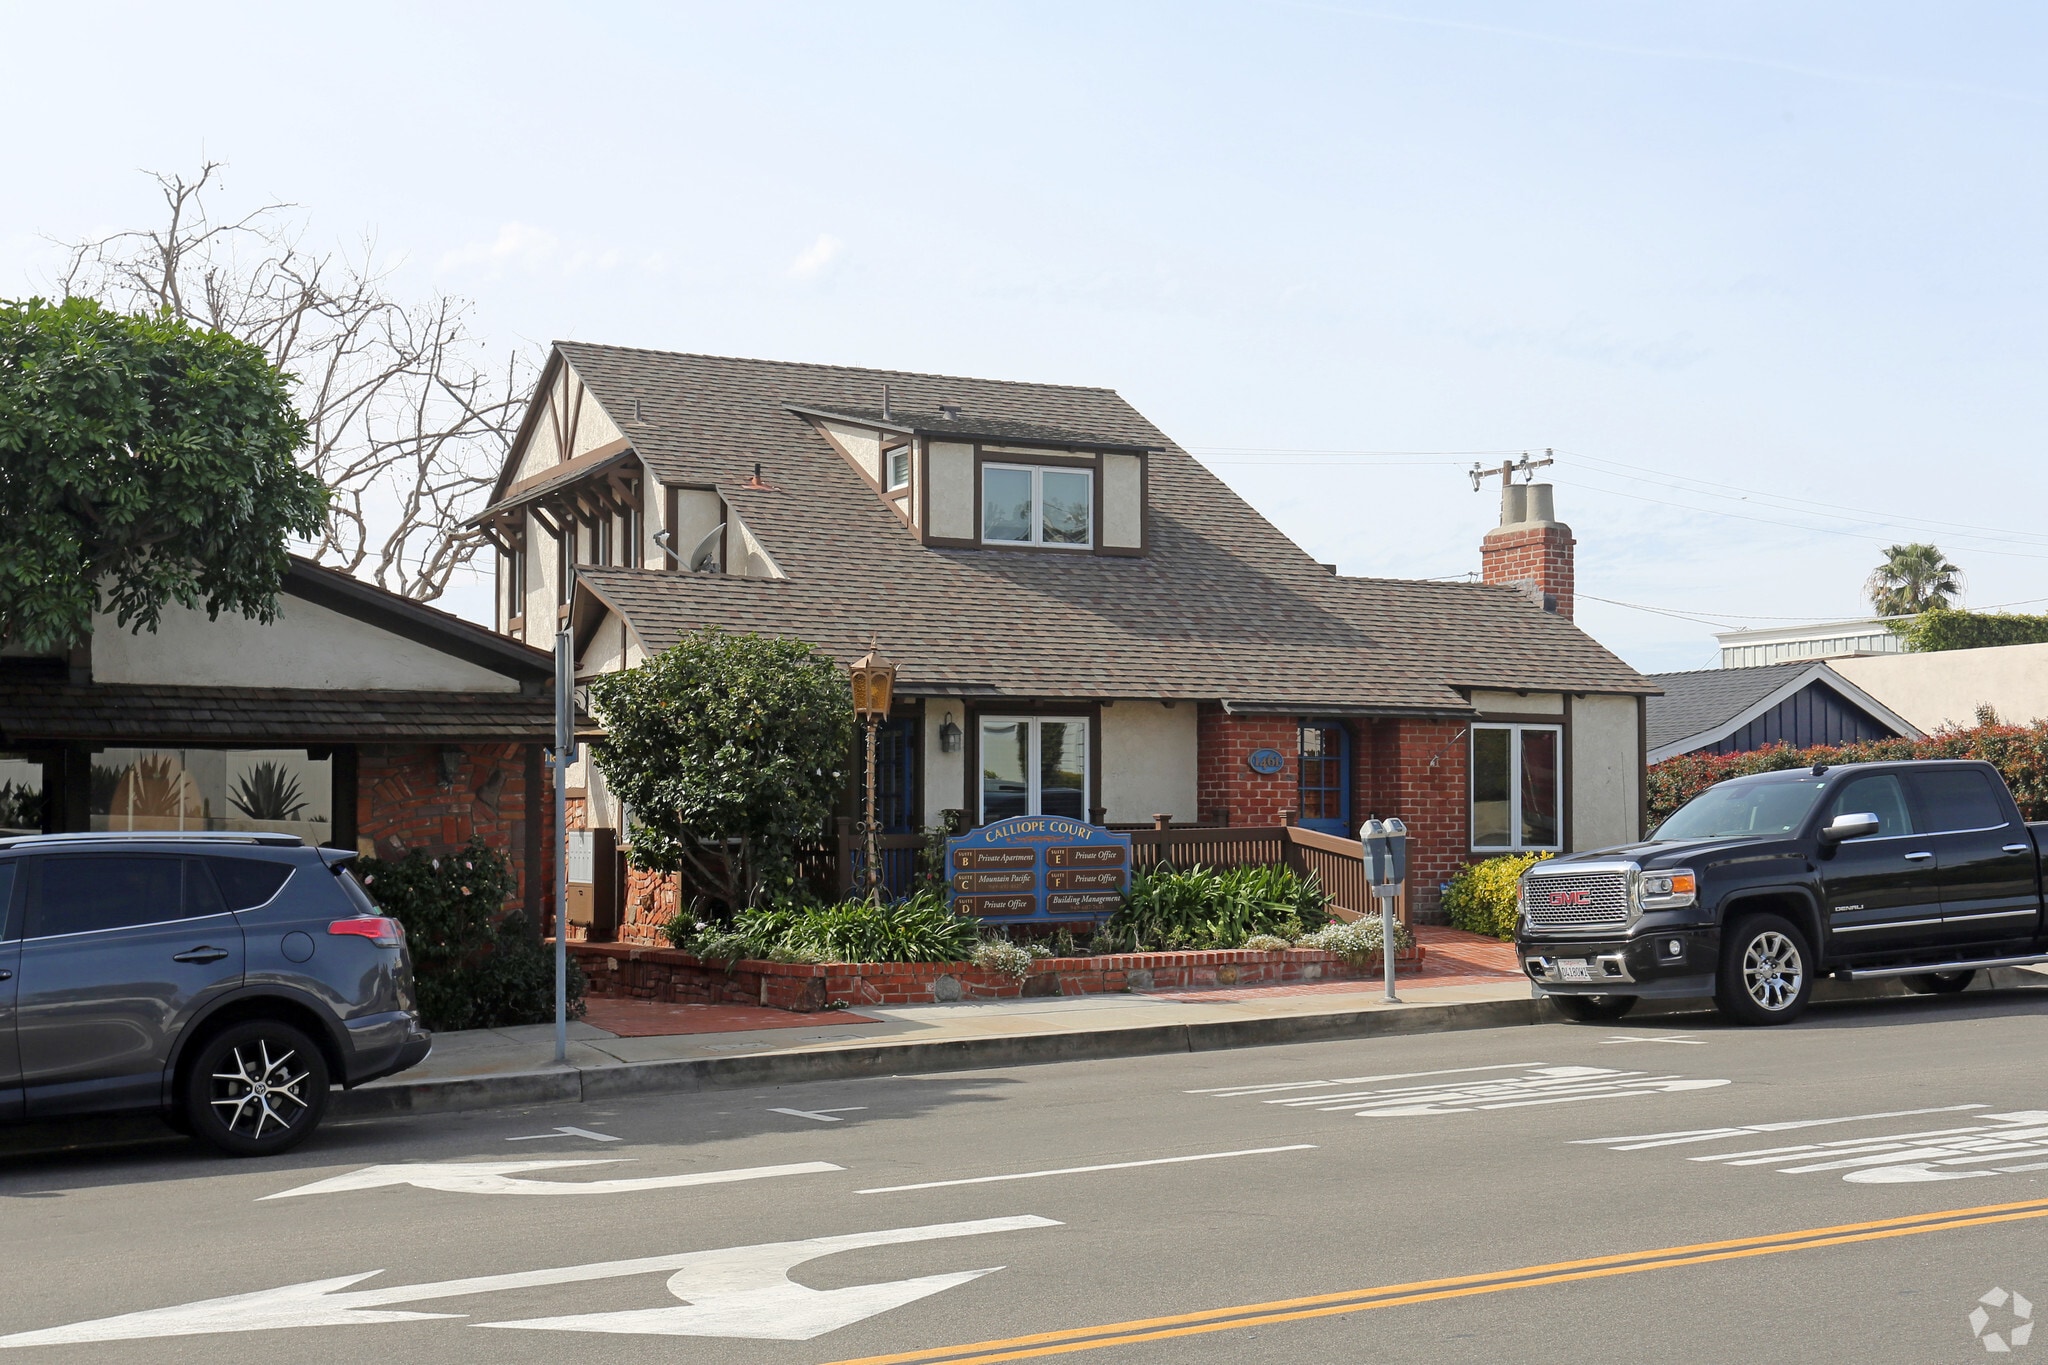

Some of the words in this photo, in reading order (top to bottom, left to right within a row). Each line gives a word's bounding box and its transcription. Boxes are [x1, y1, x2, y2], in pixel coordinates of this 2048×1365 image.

[985, 821, 1045, 842] CALLIOPE
[1049, 821, 1093, 840] COURT
[978, 853, 1000, 862] Private
[1000, 853, 1034, 864] Apartment
[1055, 855, 1061, 864] E
[1075, 851, 1097, 859] Private
[1098, 850, 1117, 861] Office
[962, 857, 969, 866] B
[978, 875, 1009, 883] Mountain
[1011, 873, 1031, 884] Pacific
[1055, 878, 1061, 887] F
[1075, 874, 1097, 883] Private
[1098, 873, 1117, 884] Office
[961, 880, 969, 890] C
[1053, 895, 1080, 905] Building
[1081, 894, 1121, 905] Management
[1549, 891, 1591, 905] GMC
[962, 904, 970, 914] D
[984, 900, 1006, 909] Private
[1008, 899, 1027, 910] Office
[1182, 1062, 1732, 1117] ONLY
